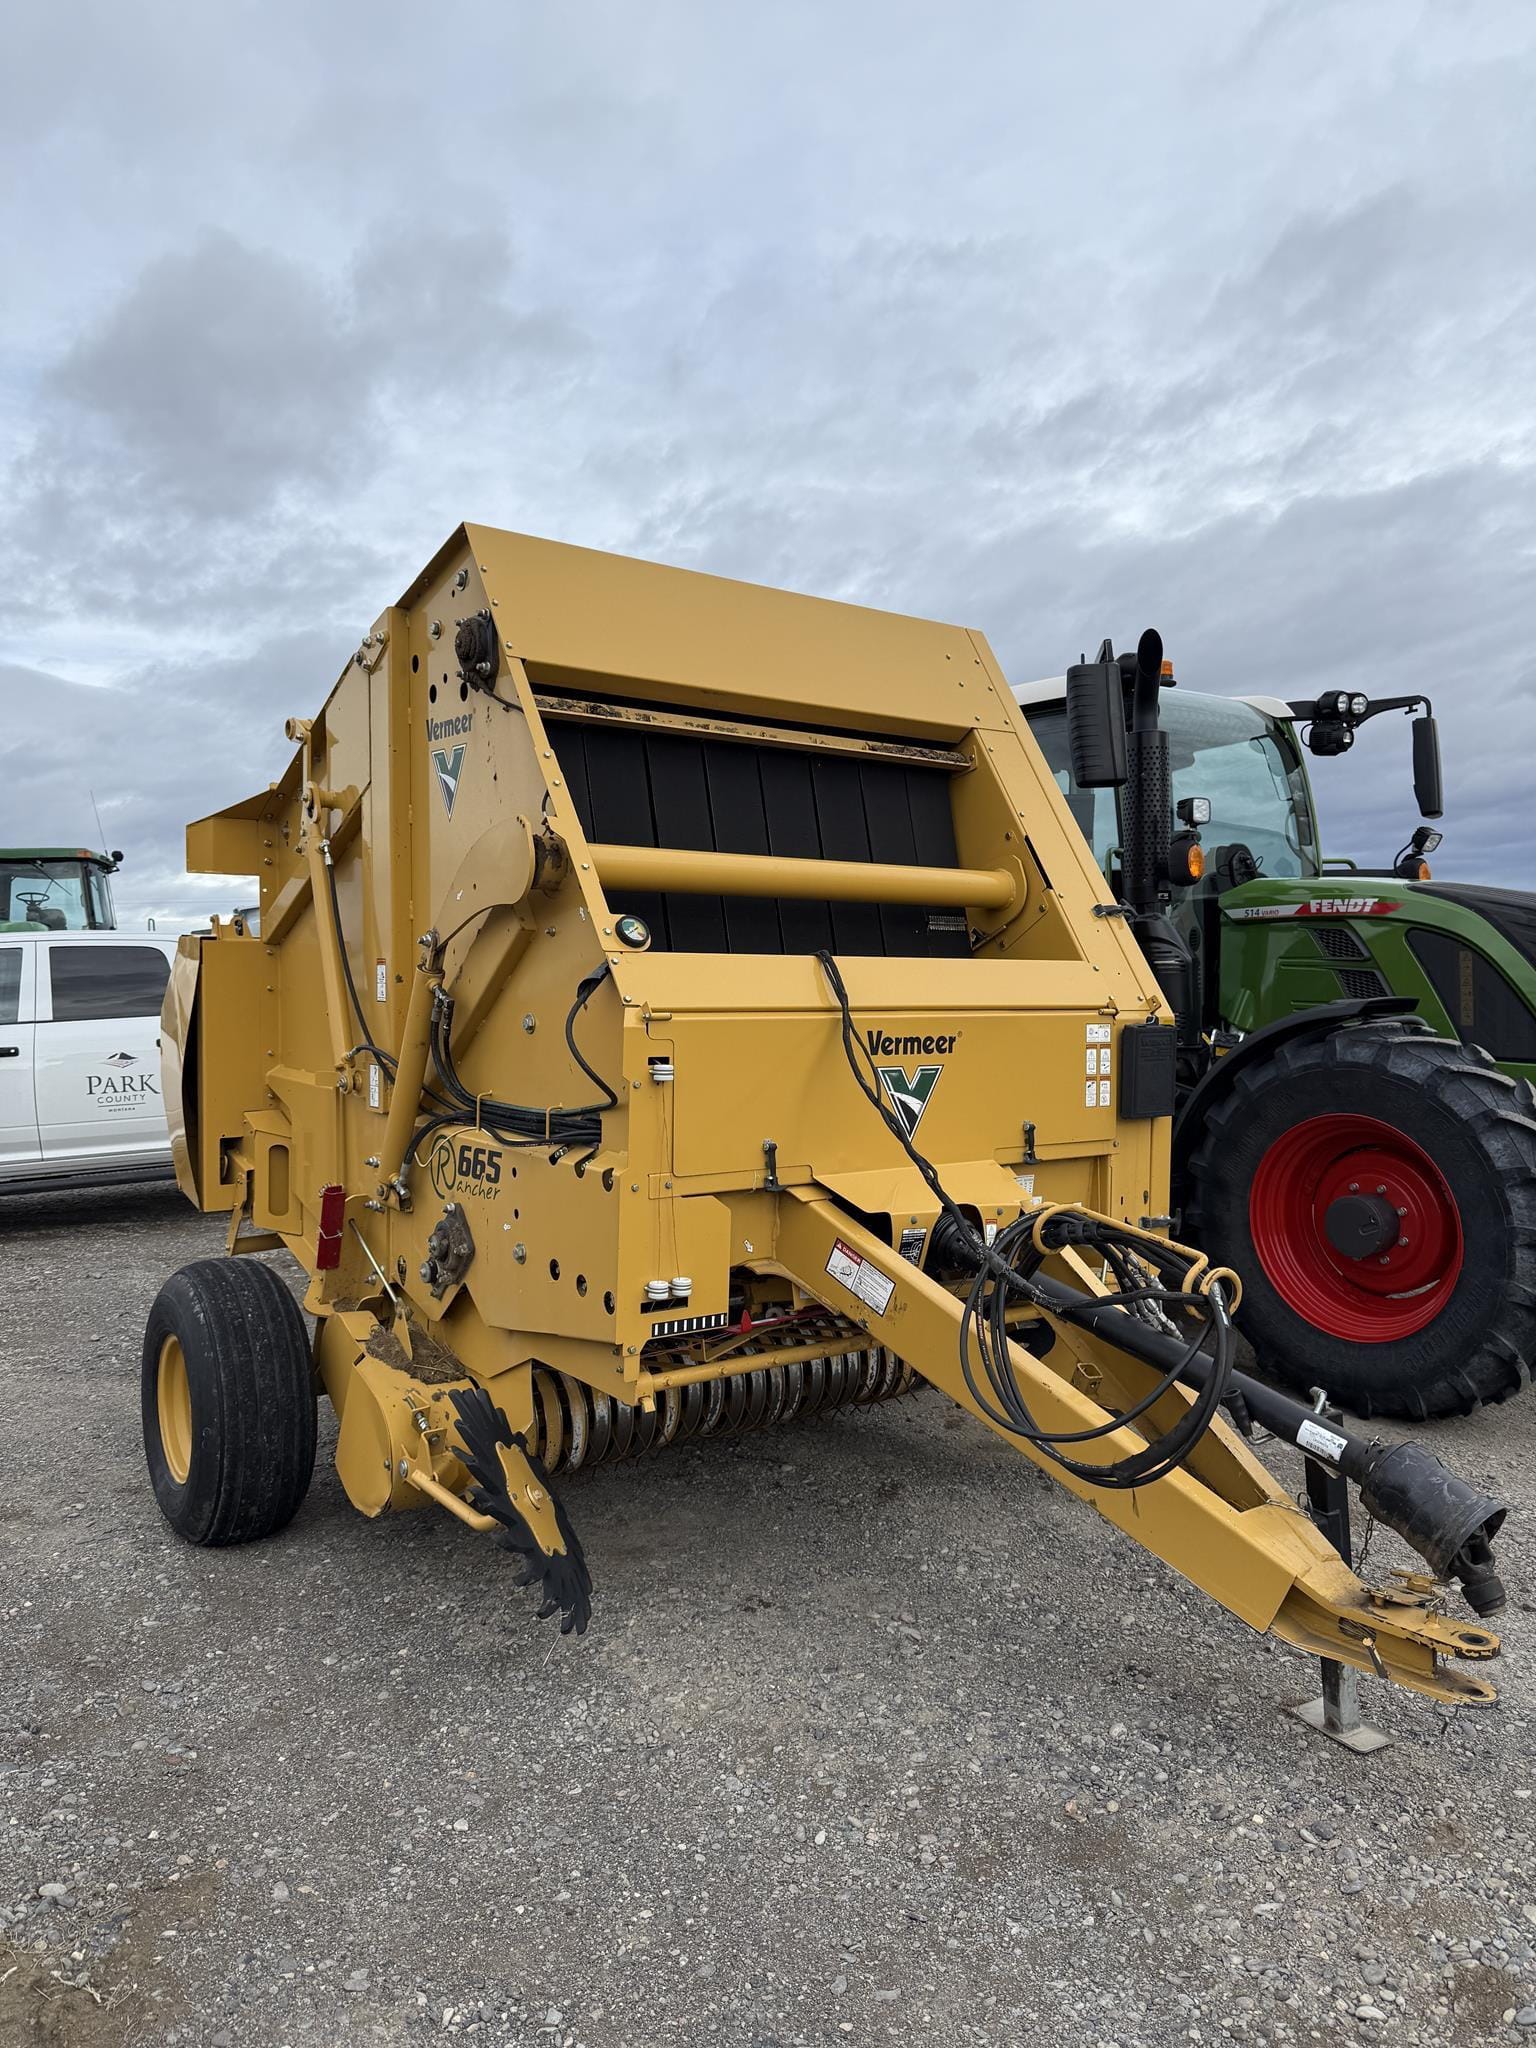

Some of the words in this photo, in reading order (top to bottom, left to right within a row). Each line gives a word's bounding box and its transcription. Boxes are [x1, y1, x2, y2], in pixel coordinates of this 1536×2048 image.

[426, 713, 473, 742] Vermeer
[1244, 908, 1260, 918] 514
[1261, 909, 1280, 917] VARIO
[1310, 898, 1379, 913] FENDT
[867, 1030, 957, 1056] Vermeer
[86, 1074, 160, 1095] PARK
[97, 1094, 146, 1104] COUNTY
[458, 1145, 502, 1184] 665
